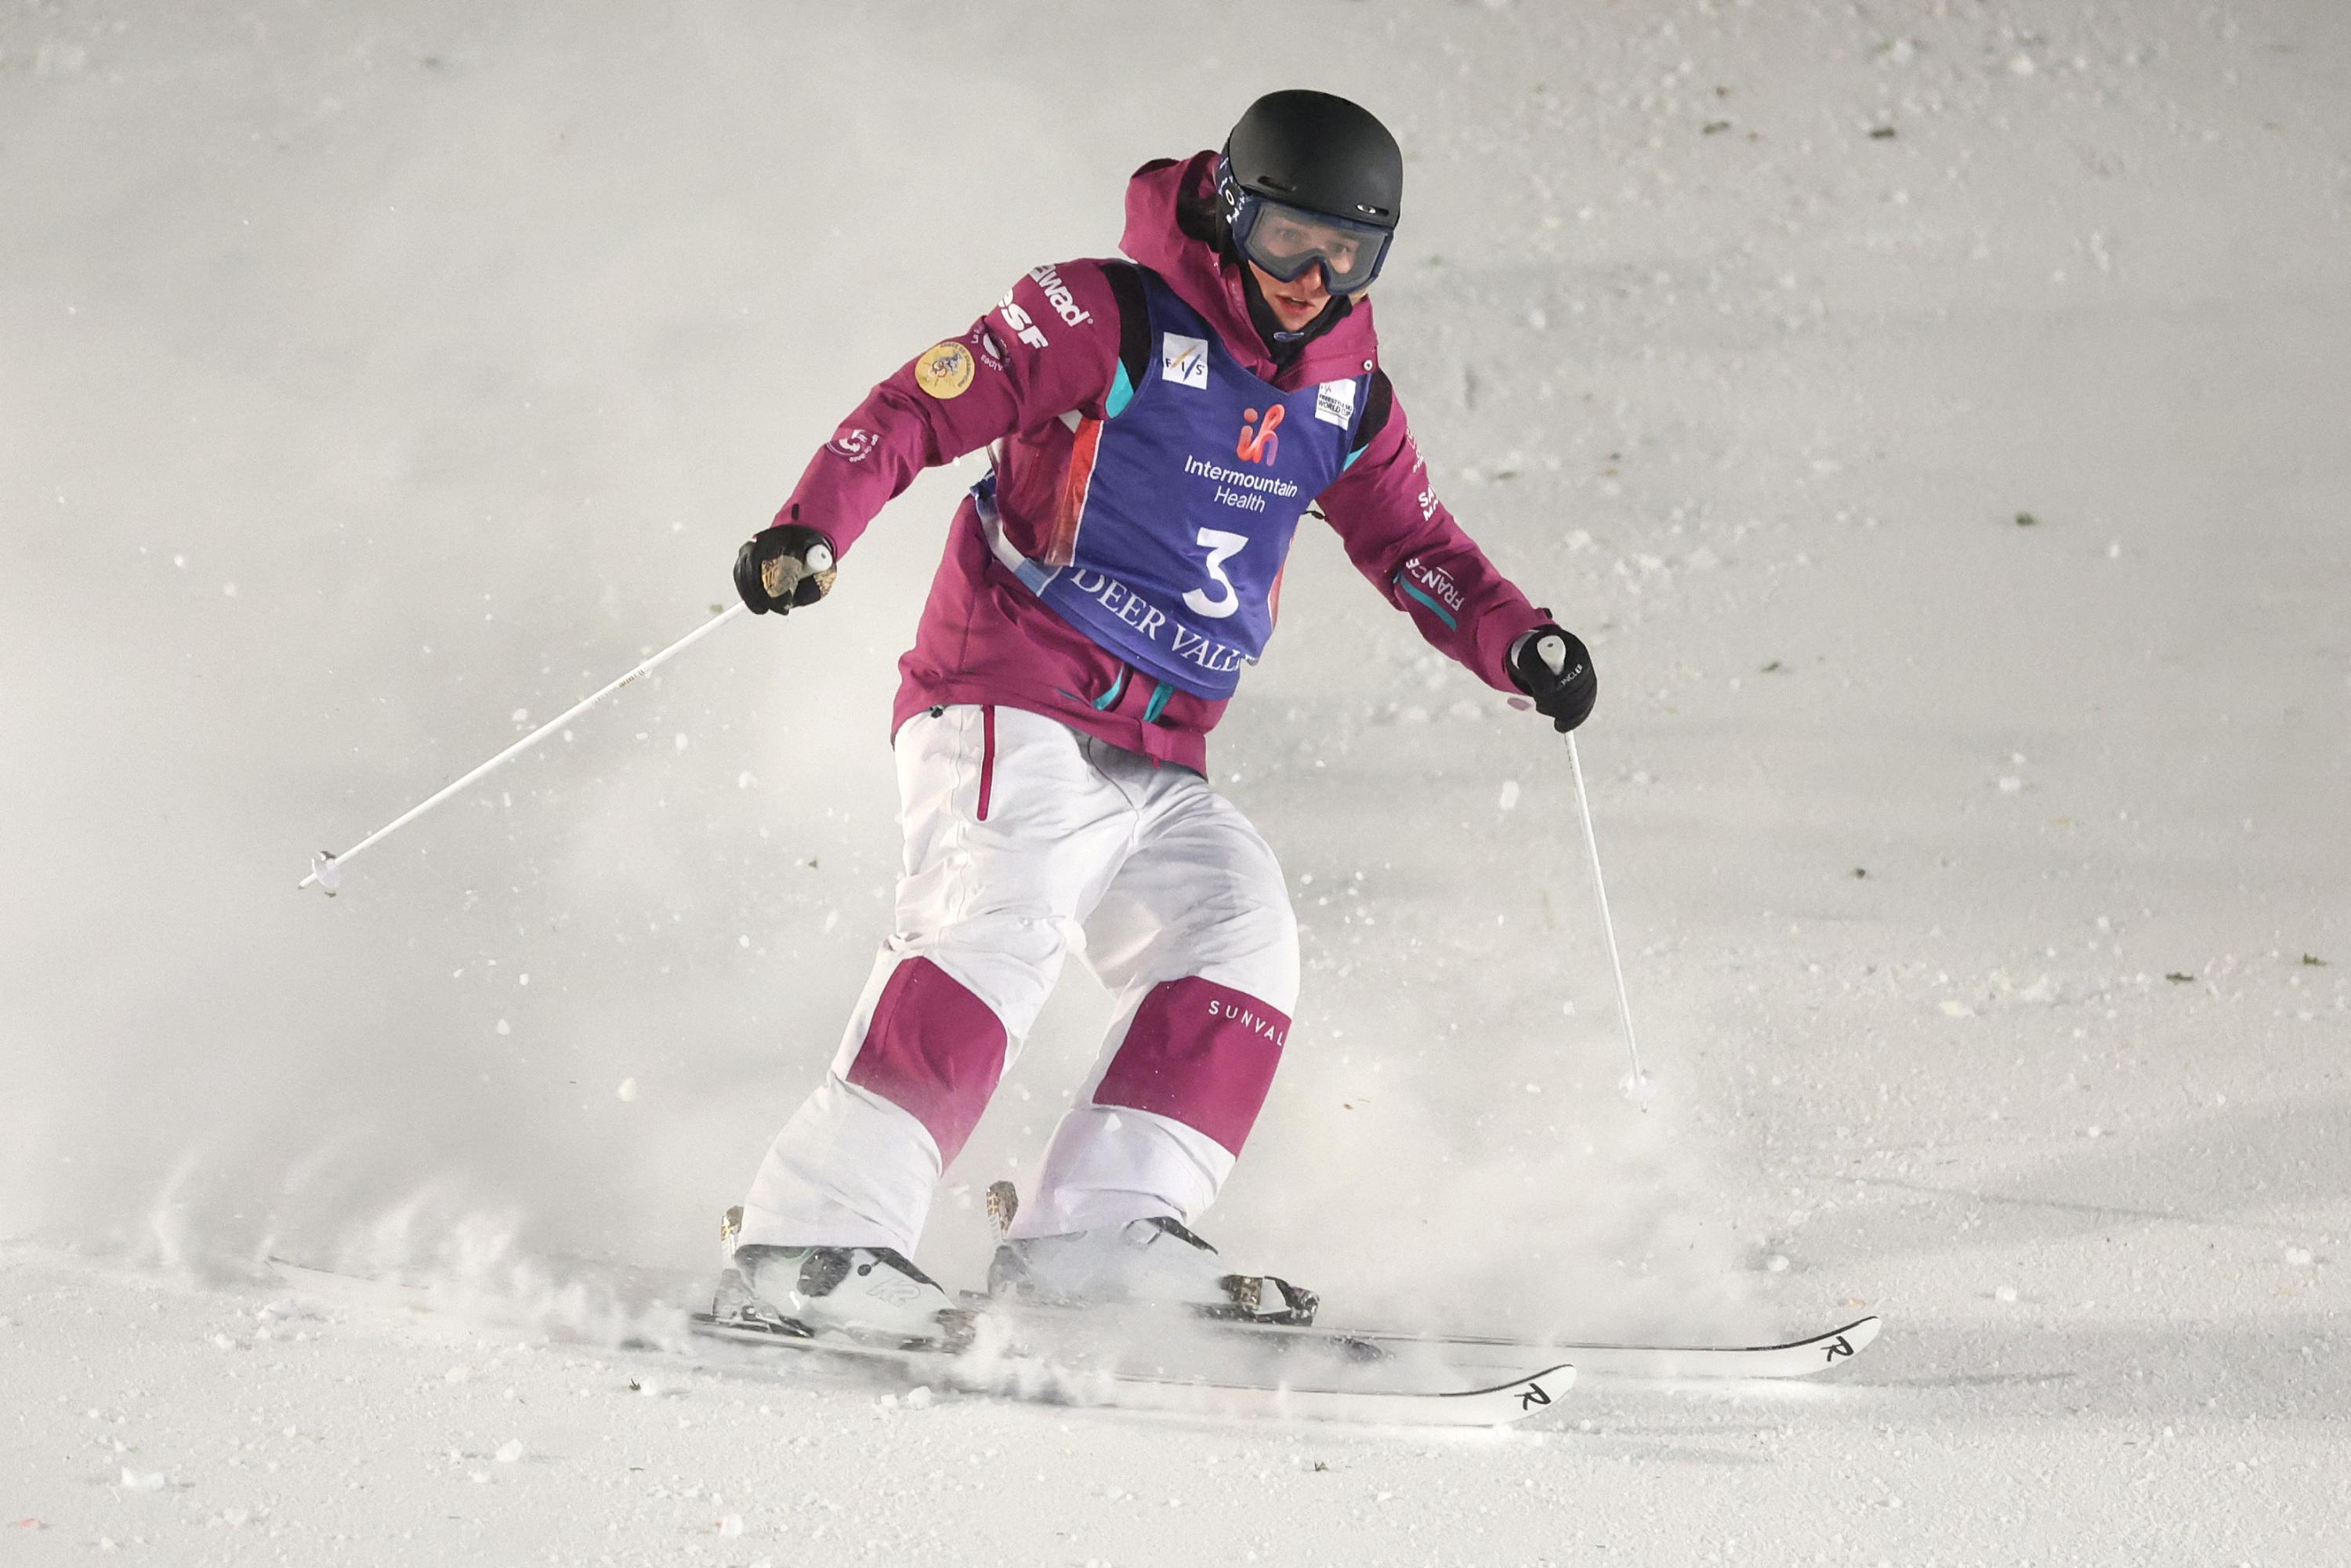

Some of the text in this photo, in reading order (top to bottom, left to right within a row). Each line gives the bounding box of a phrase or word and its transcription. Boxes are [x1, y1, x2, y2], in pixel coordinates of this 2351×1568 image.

[1184, 454, 1298, 498] Intermountain
[1214, 485, 1266, 513] Health
[1182, 527, 1249, 618] 3
[1405, 558, 1465, 611] FRANCE
[1070, 569, 1166, 640] DEER
[1208, 1000, 1283, 1047] SUNVAL
